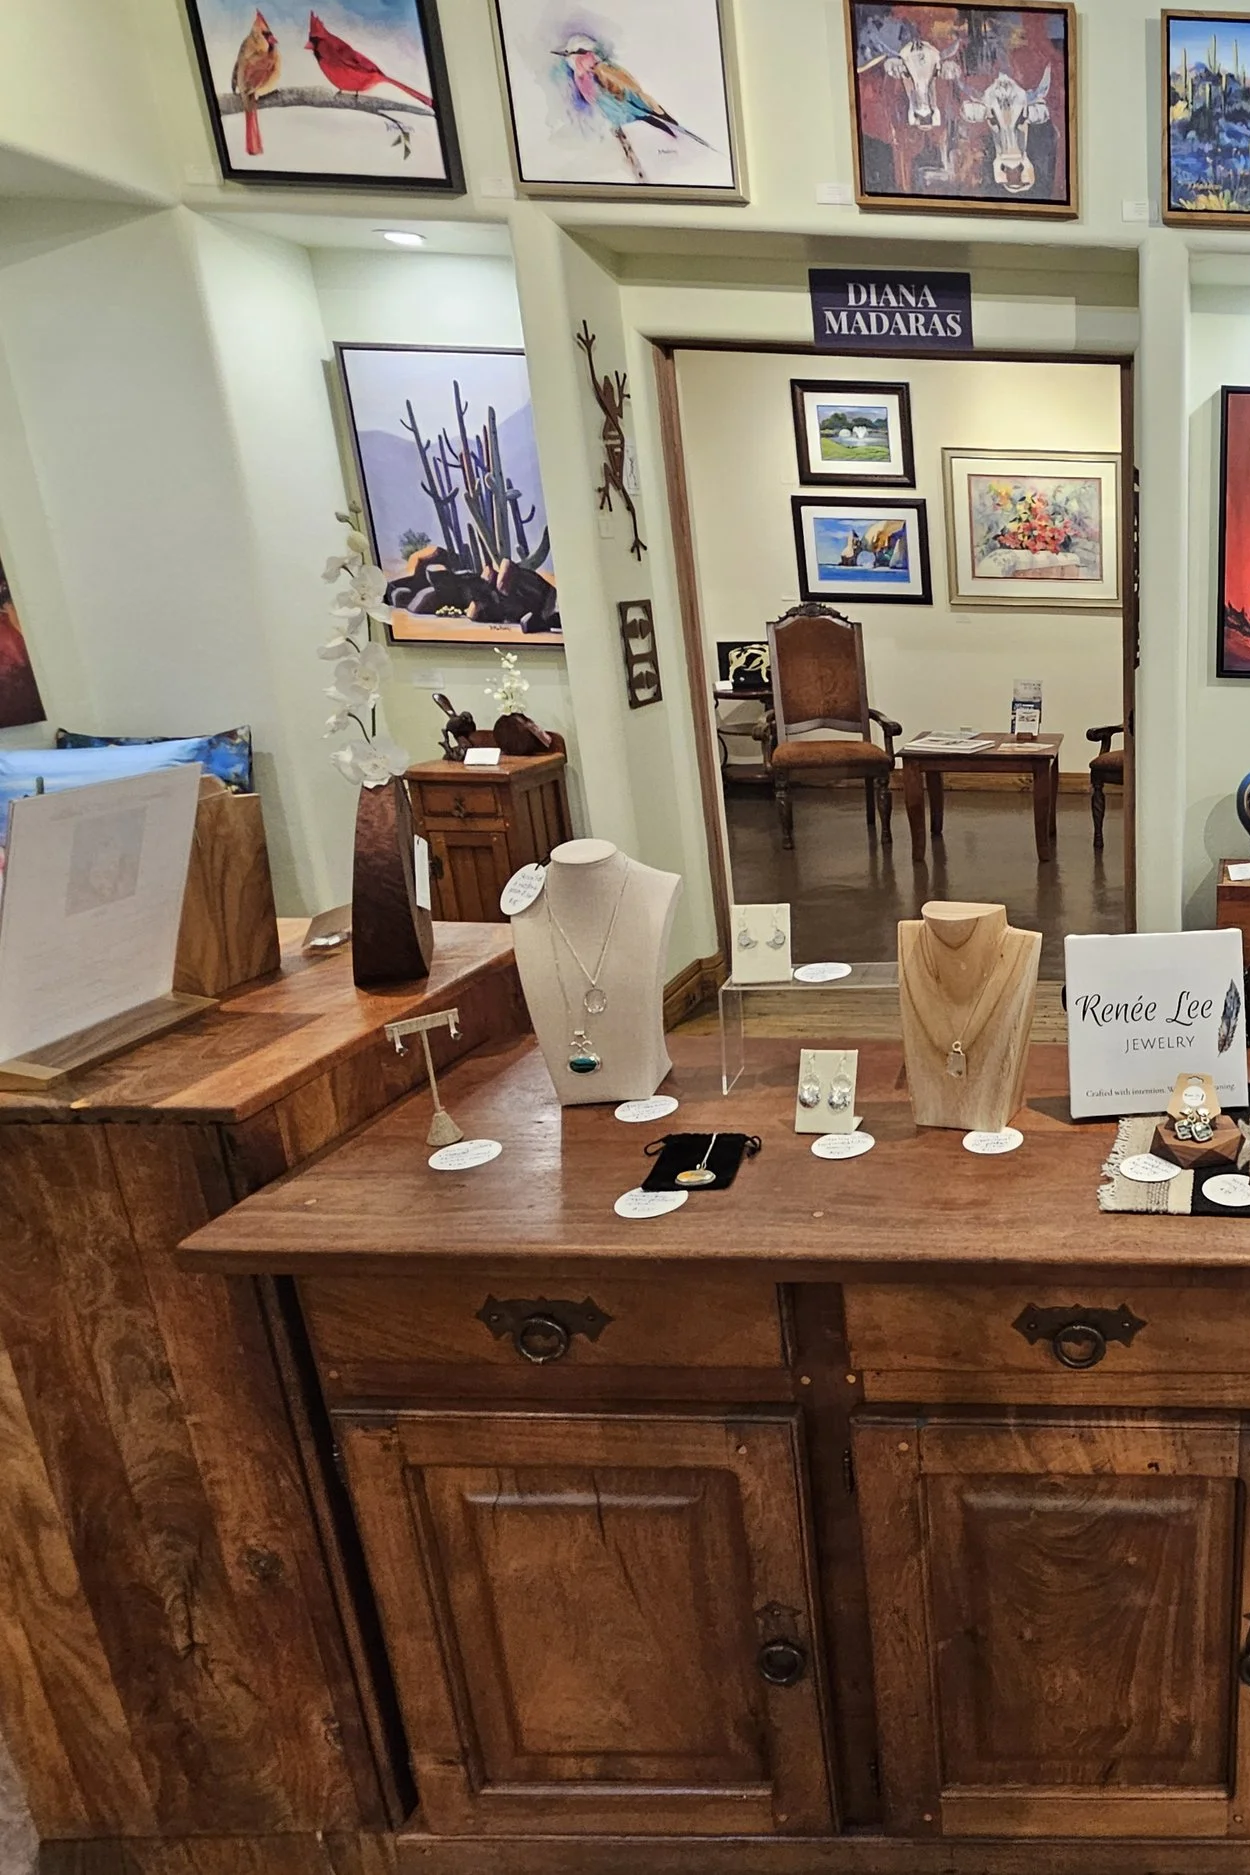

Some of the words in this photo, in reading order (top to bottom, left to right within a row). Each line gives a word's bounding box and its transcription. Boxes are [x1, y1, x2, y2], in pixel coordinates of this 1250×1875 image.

[846, 282, 938, 308] DIANA
[823, 310, 963, 338] MADARAS
[1074, 993, 1157, 1027] Renée
[1165, 990, 1213, 1027] Lee
[1125, 1035, 1196, 1053] JEWELRY
[1085, 1088, 1113, 1098] Crafted
[1114, 1088, 1131, 1097] with
